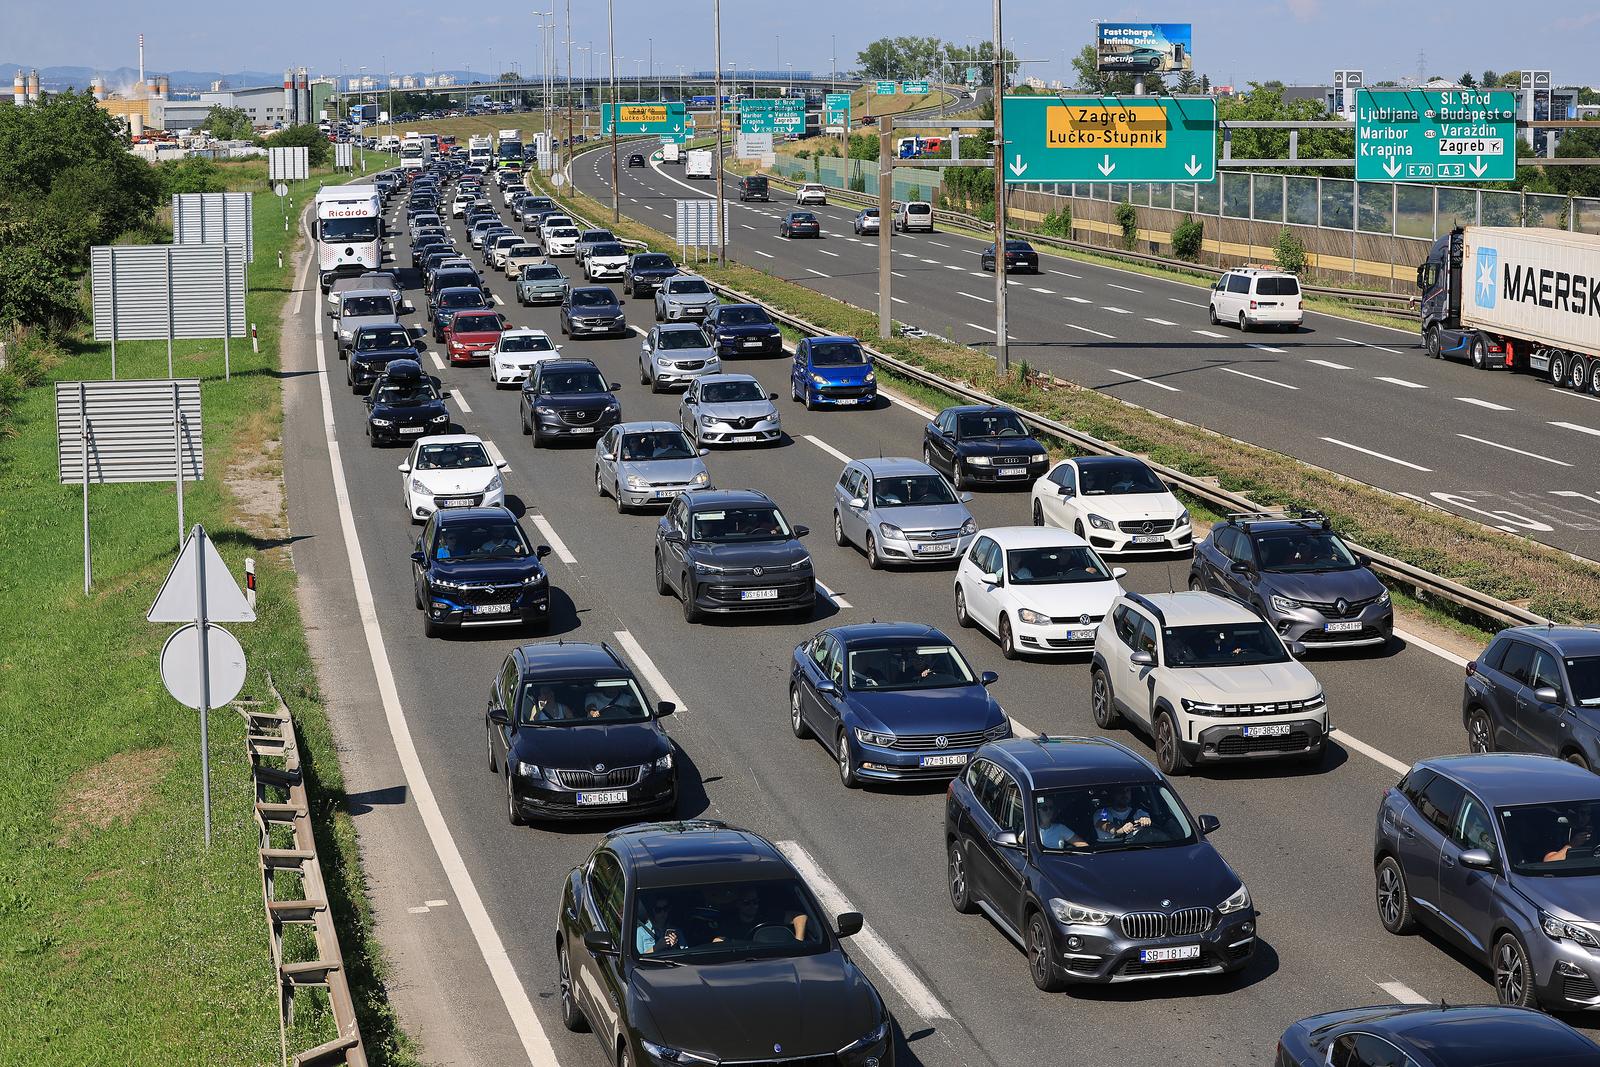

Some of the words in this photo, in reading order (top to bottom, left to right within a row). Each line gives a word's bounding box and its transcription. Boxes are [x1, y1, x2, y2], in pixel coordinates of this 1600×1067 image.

[1123, 29, 1155, 37] Charge,
[1104, 55, 1134, 63] electrip
[1441, 93, 1456, 104] Sl.
[1461, 93, 1490, 104] Brod
[1079, 110, 1136, 126] Zagreb
[1360, 107, 1418, 123] Ljubljana
[1441, 108, 1499, 123] Budapest
[1360, 127, 1408, 139] Maribor
[1441, 123, 1496, 136] Varaždin
[1049, 129, 1162, 146] Lučko-Stupnik
[1360, 143, 1413, 159] Krapina
[1440, 139, 1484, 154] Zagreb
[1409, 166, 1415, 176] E
[1419, 166, 1431, 176] 70
[1442, 166, 1450, 176] A
[1454, 166, 1460, 176] 3
[329, 209, 368, 217] Ricardo
[1503, 263, 1600, 317] MAERSK
[1249, 727, 1258, 735] ZG
[583, 794, 592, 803] NG
[1147, 951, 1158, 960] SB
